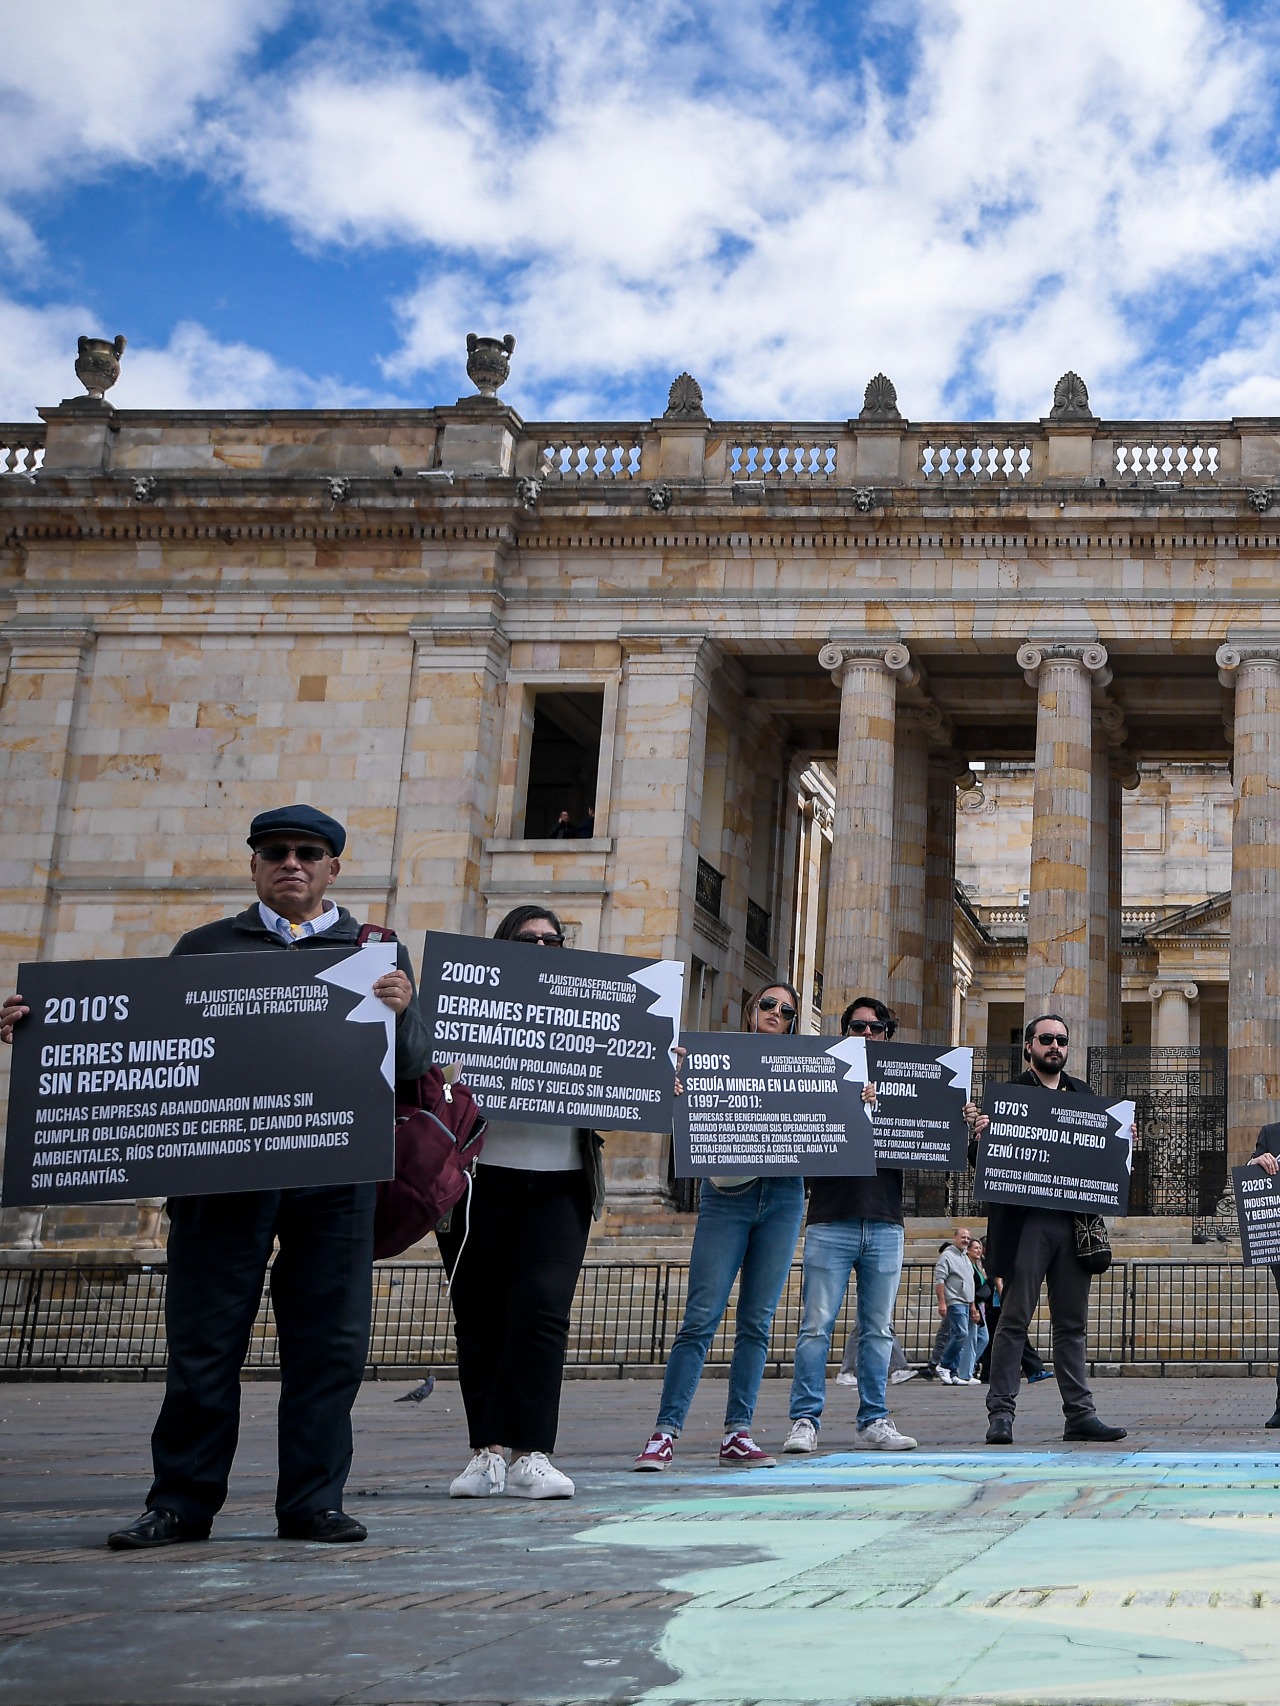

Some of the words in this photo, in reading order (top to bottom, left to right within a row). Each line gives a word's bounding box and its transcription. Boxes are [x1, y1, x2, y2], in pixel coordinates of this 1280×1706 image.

[440, 961, 500, 986] 2000'S
[538, 972, 636, 993] #LAJUSTICIASEFRACTURA
[185, 984, 328, 1004] #LAJUSTICIASEFRACTURA
[202, 1001, 243, 1017] ¿QUIÉN
[246, 1001, 260, 1014] LA
[263, 995, 328, 1013] FRACTURA?
[549, 984, 578, 997] ¿QUIÉN
[579, 987, 589, 998] LA
[591, 989, 636, 1003] FRACTURA?
[44, 994, 129, 1023] 2010'S
[437, 994, 523, 1021] DERRAMES
[525, 1004, 620, 1031] PETROLEROS
[434, 1020, 545, 1049] SISTEMÁTICOS
[40, 1041, 123, 1066] CIERRES
[128, 1036, 215, 1062] MINEROS
[38, 1071, 72, 1094] SIN
[77, 1061, 199, 1093] REPARACIÓN
[519, 1058, 586, 1077] PROLONGADA
[588, 1064, 603, 1078] DE
[459, 1068, 505, 1090] STEMAS,
[510, 1075, 535, 1091] RÍOS
[537, 1079, 544, 1092] Y
[545, 1080, 584, 1096] SUELOS
[586, 1083, 603, 1097] SIN
[605, 1085, 661, 1102] SANCIONES
[686, 1074, 724, 1091] SEQUÍA
[725, 1077, 766, 1091] MINERA
[767, 1078, 781, 1092] EN
[782, 1078, 796, 1092] LA
[797, 1078, 838, 1092] GUAJIRA
[874, 1080, 917, 1097] LABORAL
[35, 1106, 88, 1123] MUCHAS
[91, 1102, 157, 1119] EMPRESAS
[159, 1096, 250, 1115] ABANDONARON
[252, 1093, 290, 1109] MINAS
[293, 1092, 313, 1106] SIN
[486, 1094, 507, 1108] QUE
[508, 1096, 555, 1112] AFECTAN
[556, 1100, 564, 1113] A
[566, 1101, 641, 1120] COMUNIDADES.
[34, 1127, 89, 1144] CUMPLIR
[92, 1122, 179, 1141] OBLIGACIONES
[182, 1120, 198, 1135] DE
[200, 1117, 246, 1134] CIERRE,
[249, 1114, 302, 1130] DEJANDO
[305, 1110, 353, 1127] PASIVOS
[989, 1121, 1058, 1142] HIDRODESPOJO
[1059, 1130, 1071, 1144] AL
[1072, 1132, 1105, 1149] PUEBLO
[32, 1147, 122, 1166] AMBIENTALES,
[125, 1143, 154, 1160] RÍOS
[156, 1138, 251, 1158] CONTAMINADOS
[253, 1137, 262, 1151] Y
[264, 1131, 349, 1150] COMUNIDADES
[986, 1143, 1013, 1158] ZENÚ
[1014, 1146, 1049, 1163] (1971):
[31, 1172, 52, 1188] SIN
[55, 1166, 128, 1186] GARANTÍAS.
[984, 1167, 1022, 1180] PROYECTOS
[1022, 1170, 1052, 1183] HÍDRICOS
[1051, 1174, 1079, 1187] ALTERAN
[1079, 1178, 1118, 1192] ECOSISTEMAS
[1243, 1194, 1280, 1208] INDUSTRIA
[1244, 1211, 1250, 1221] Y
